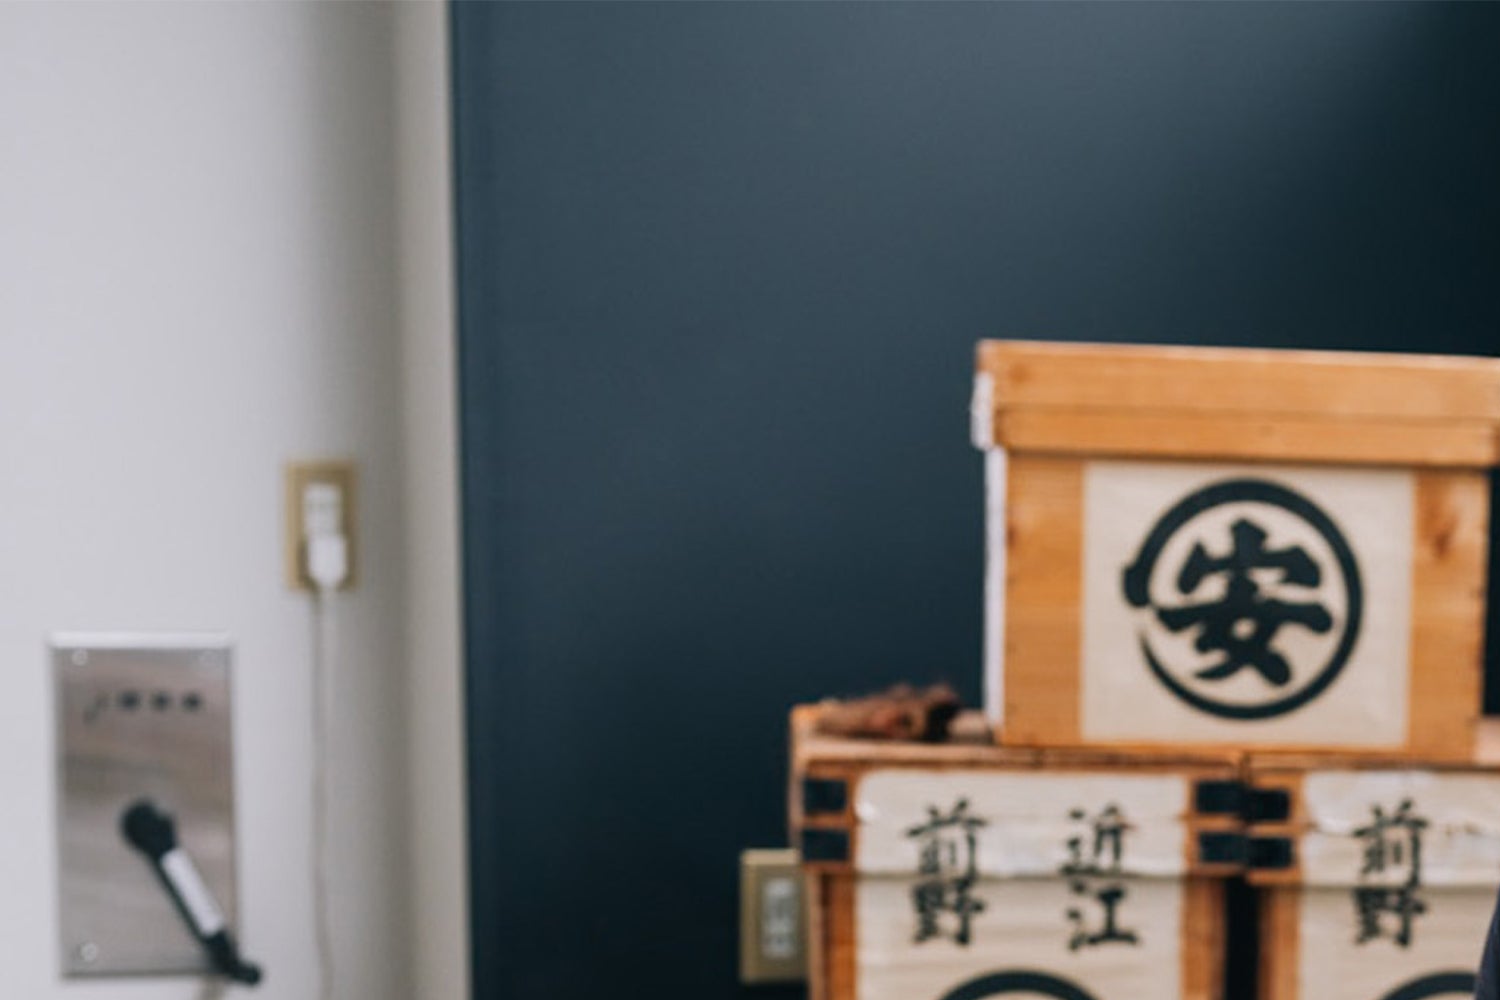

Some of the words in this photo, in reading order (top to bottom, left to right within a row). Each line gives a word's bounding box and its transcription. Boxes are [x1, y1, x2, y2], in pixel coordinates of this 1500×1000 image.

[1155, 516, 1334, 688] 安
[906, 799, 989, 948] 前野
[1060, 804, 1141, 951] 近江
[1351, 799, 1431, 948] 前野
